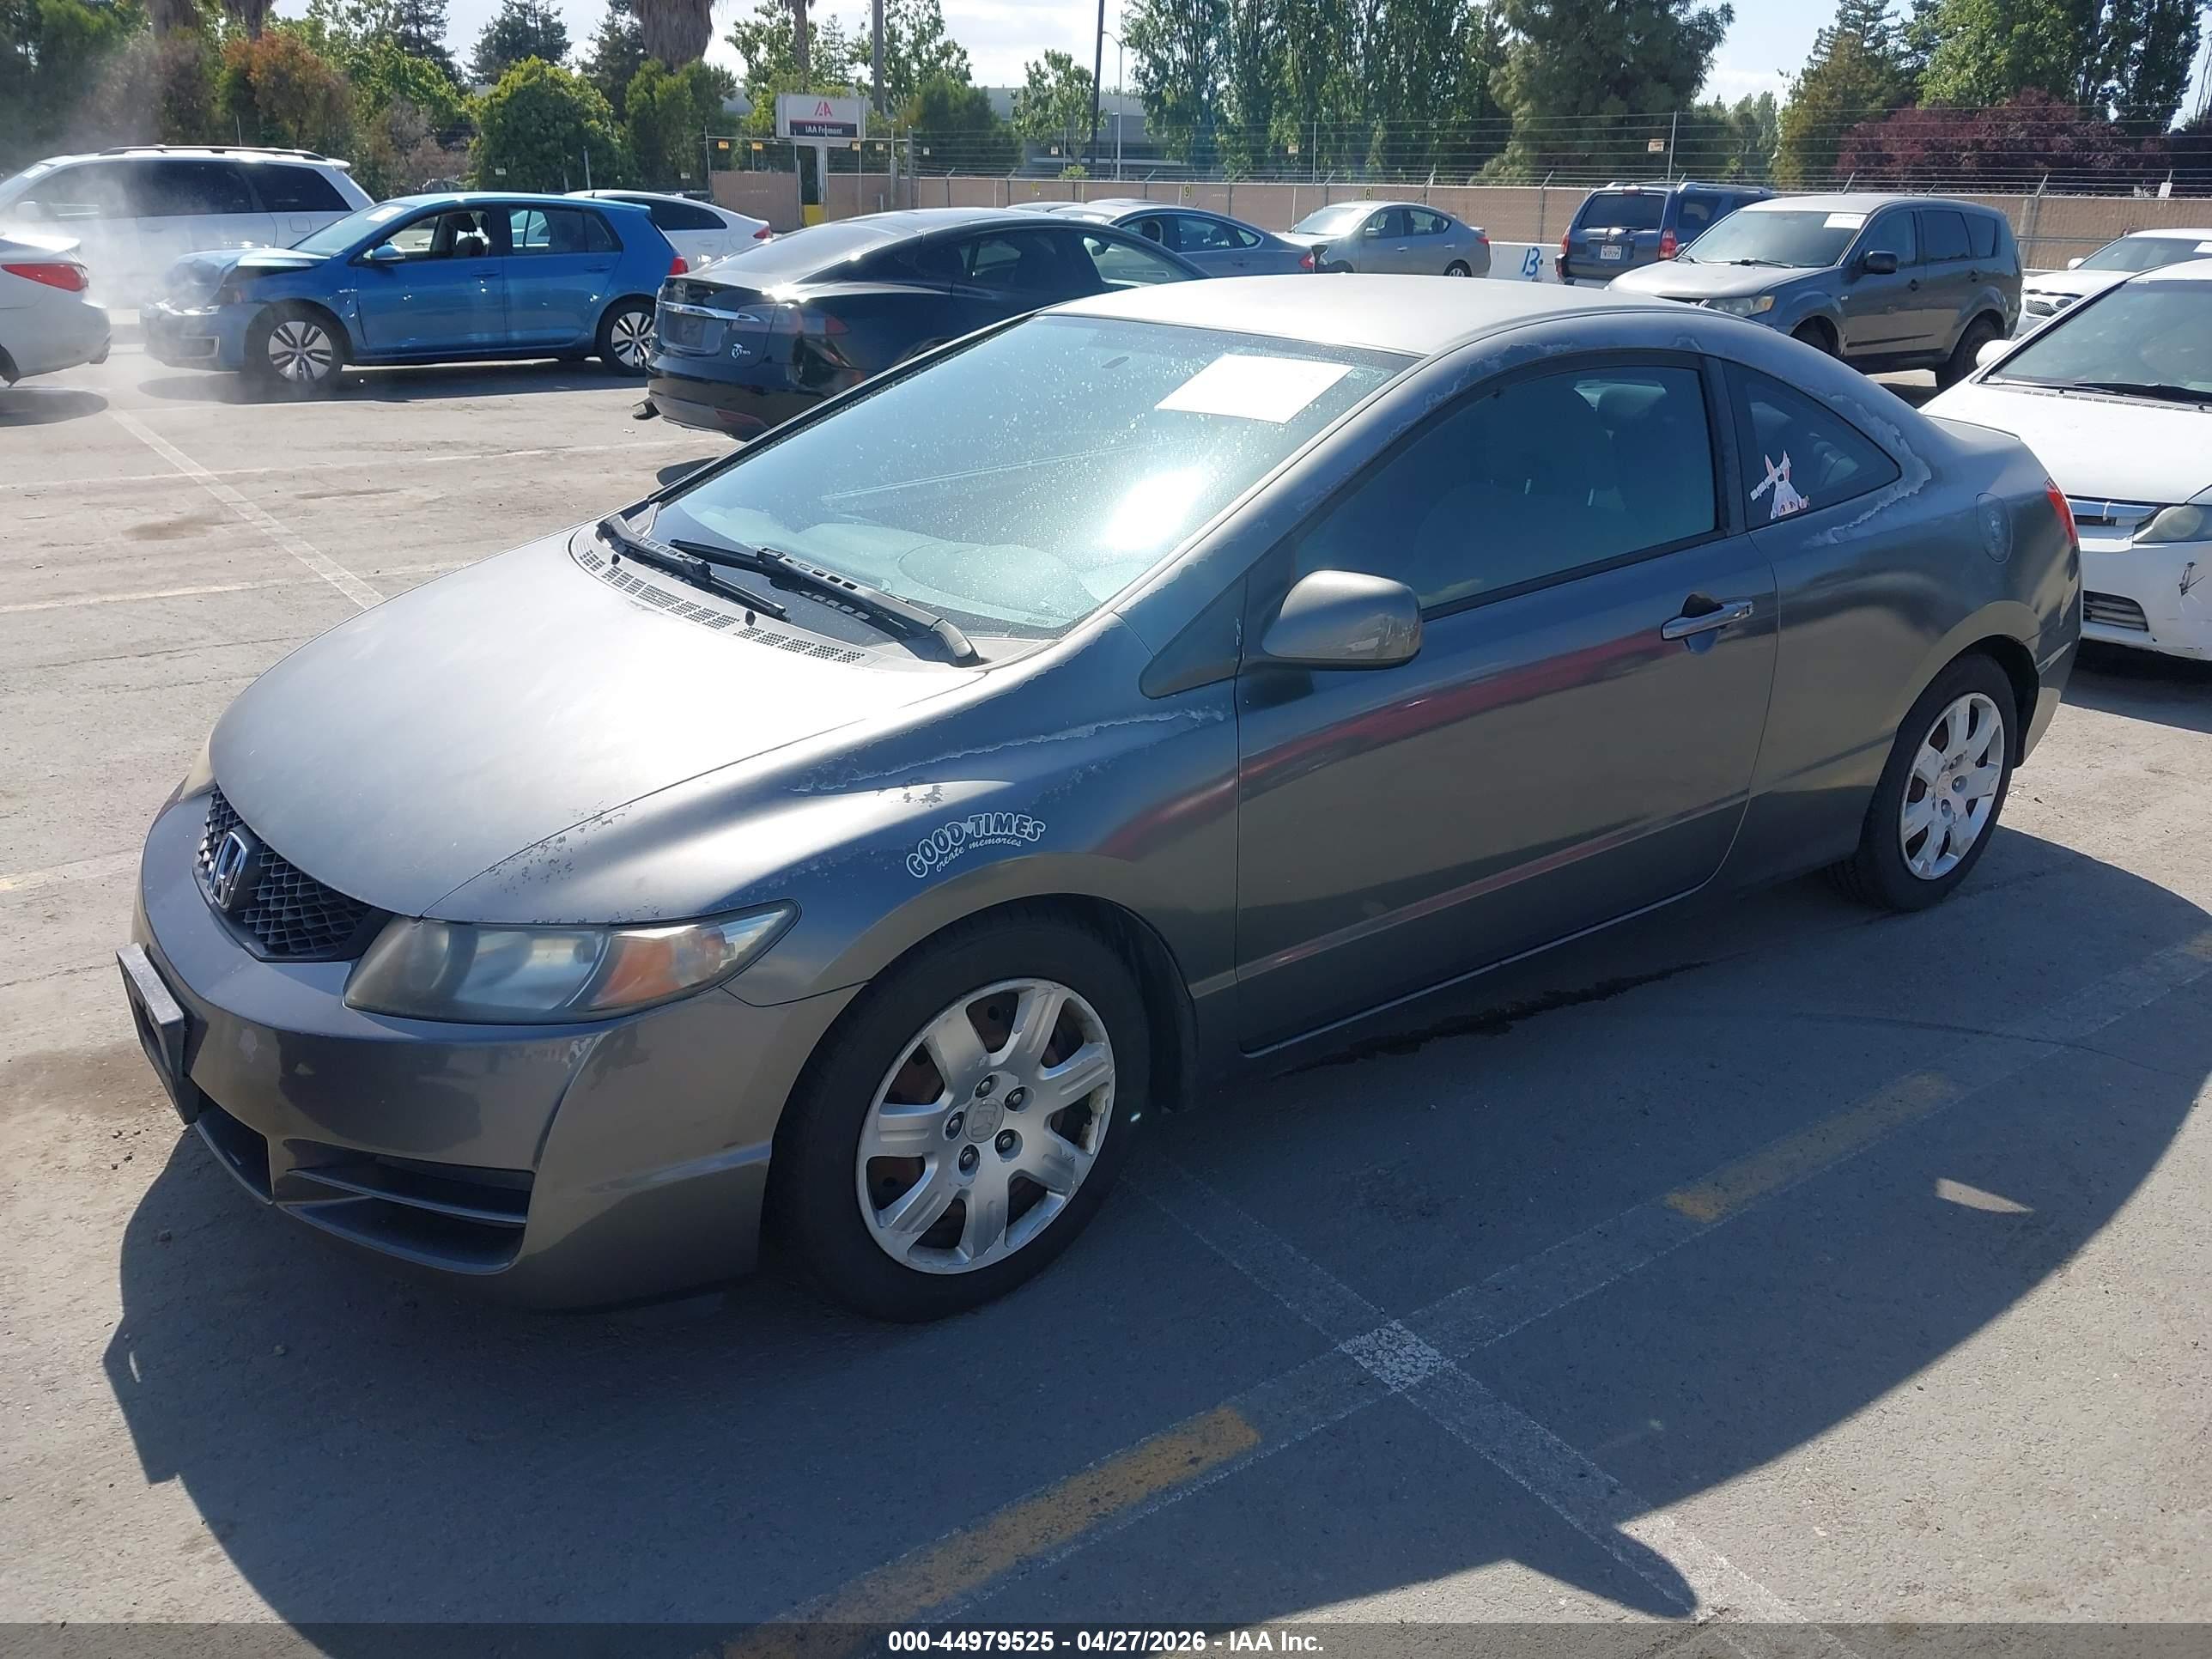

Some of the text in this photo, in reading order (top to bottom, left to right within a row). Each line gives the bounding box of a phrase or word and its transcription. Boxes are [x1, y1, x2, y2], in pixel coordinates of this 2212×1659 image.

[805, 125, 817, 134] IAA
[906, 811, 1046, 878] GOOD TIMES
[936, 836, 1022, 872] create memories
